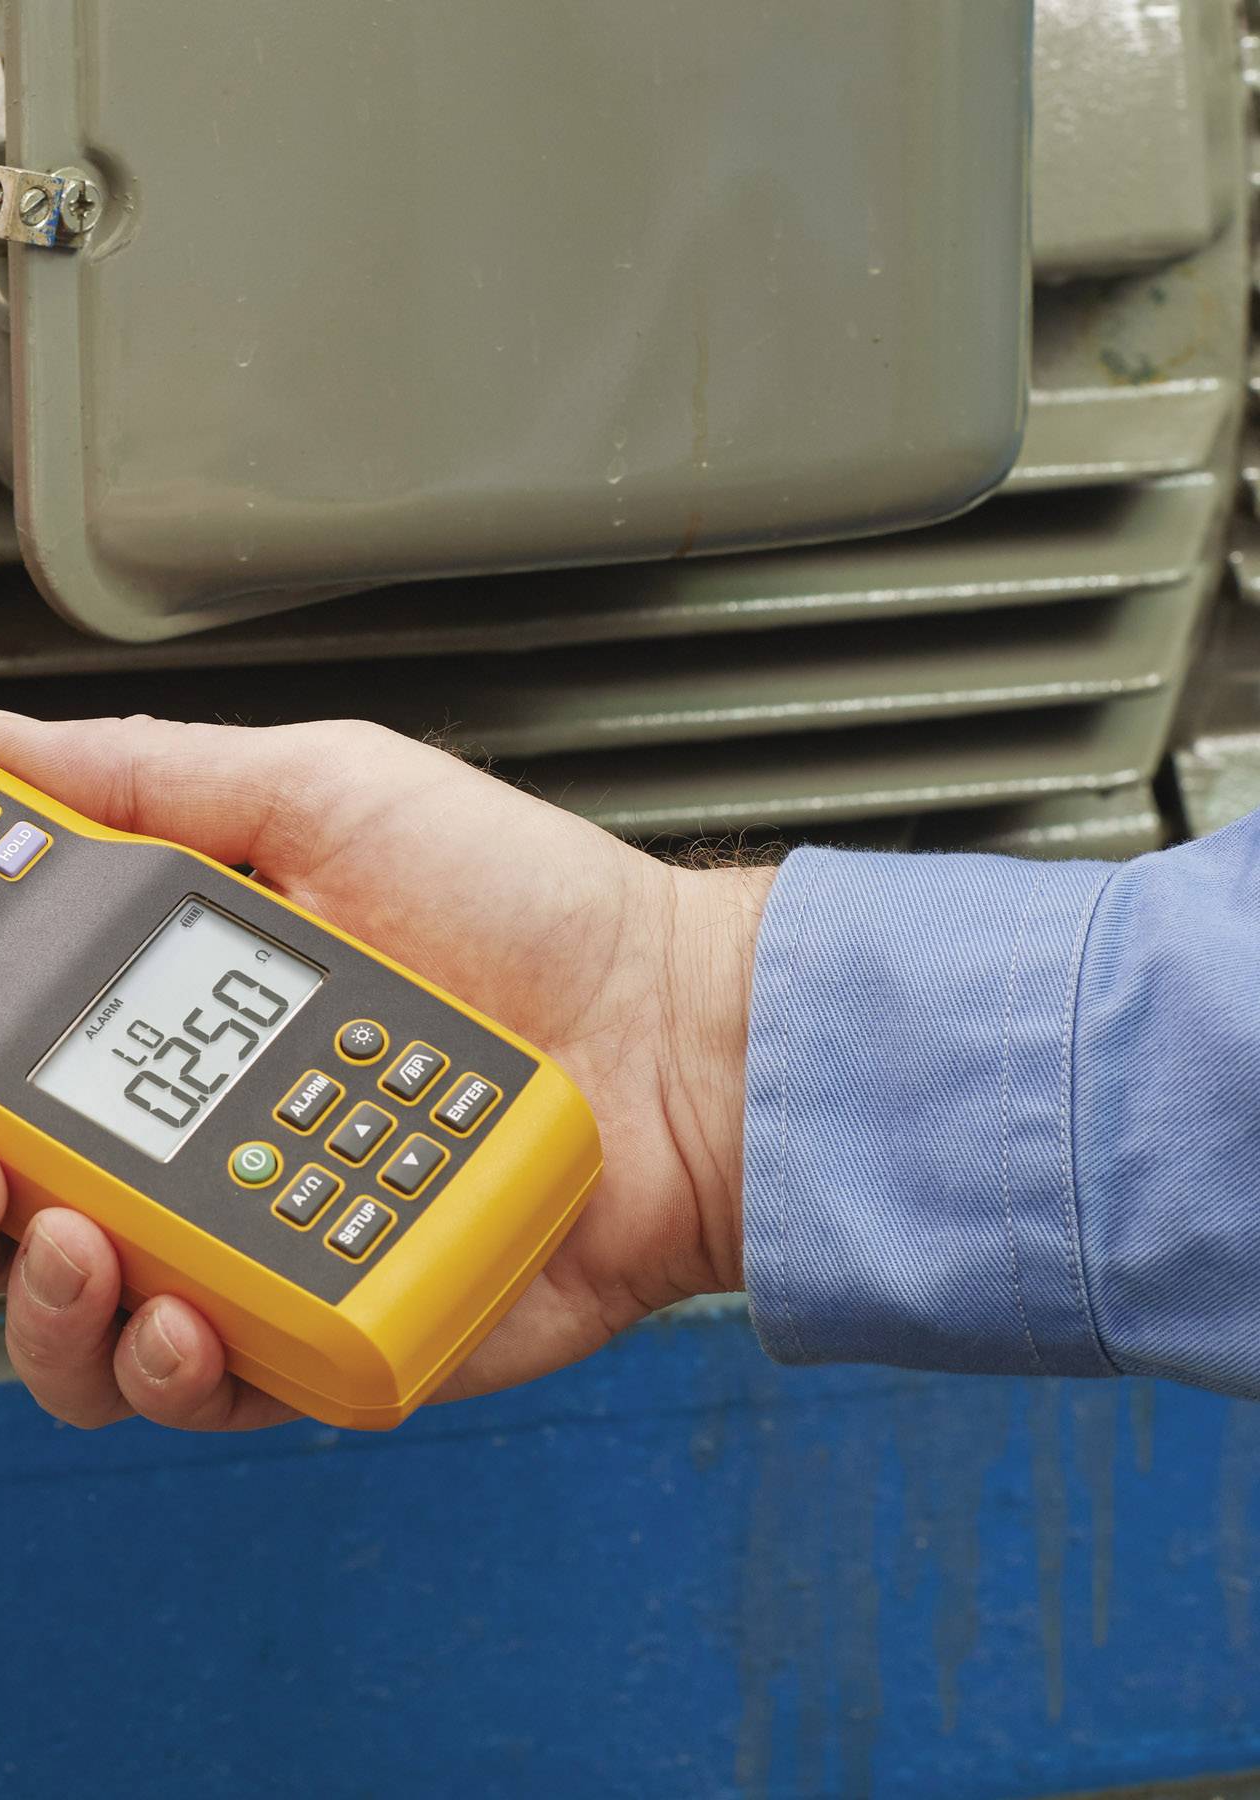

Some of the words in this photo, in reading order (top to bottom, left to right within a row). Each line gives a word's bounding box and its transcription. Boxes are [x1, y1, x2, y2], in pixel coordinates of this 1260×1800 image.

[85, 998, 124, 1040] ALARM
[124, 970, 289, 1128] 0.250
[290, 1075, 330, 1117] ALARM
[446, 1080, 488, 1122] ENTER
[338, 1202, 377, 1245] SETUP
